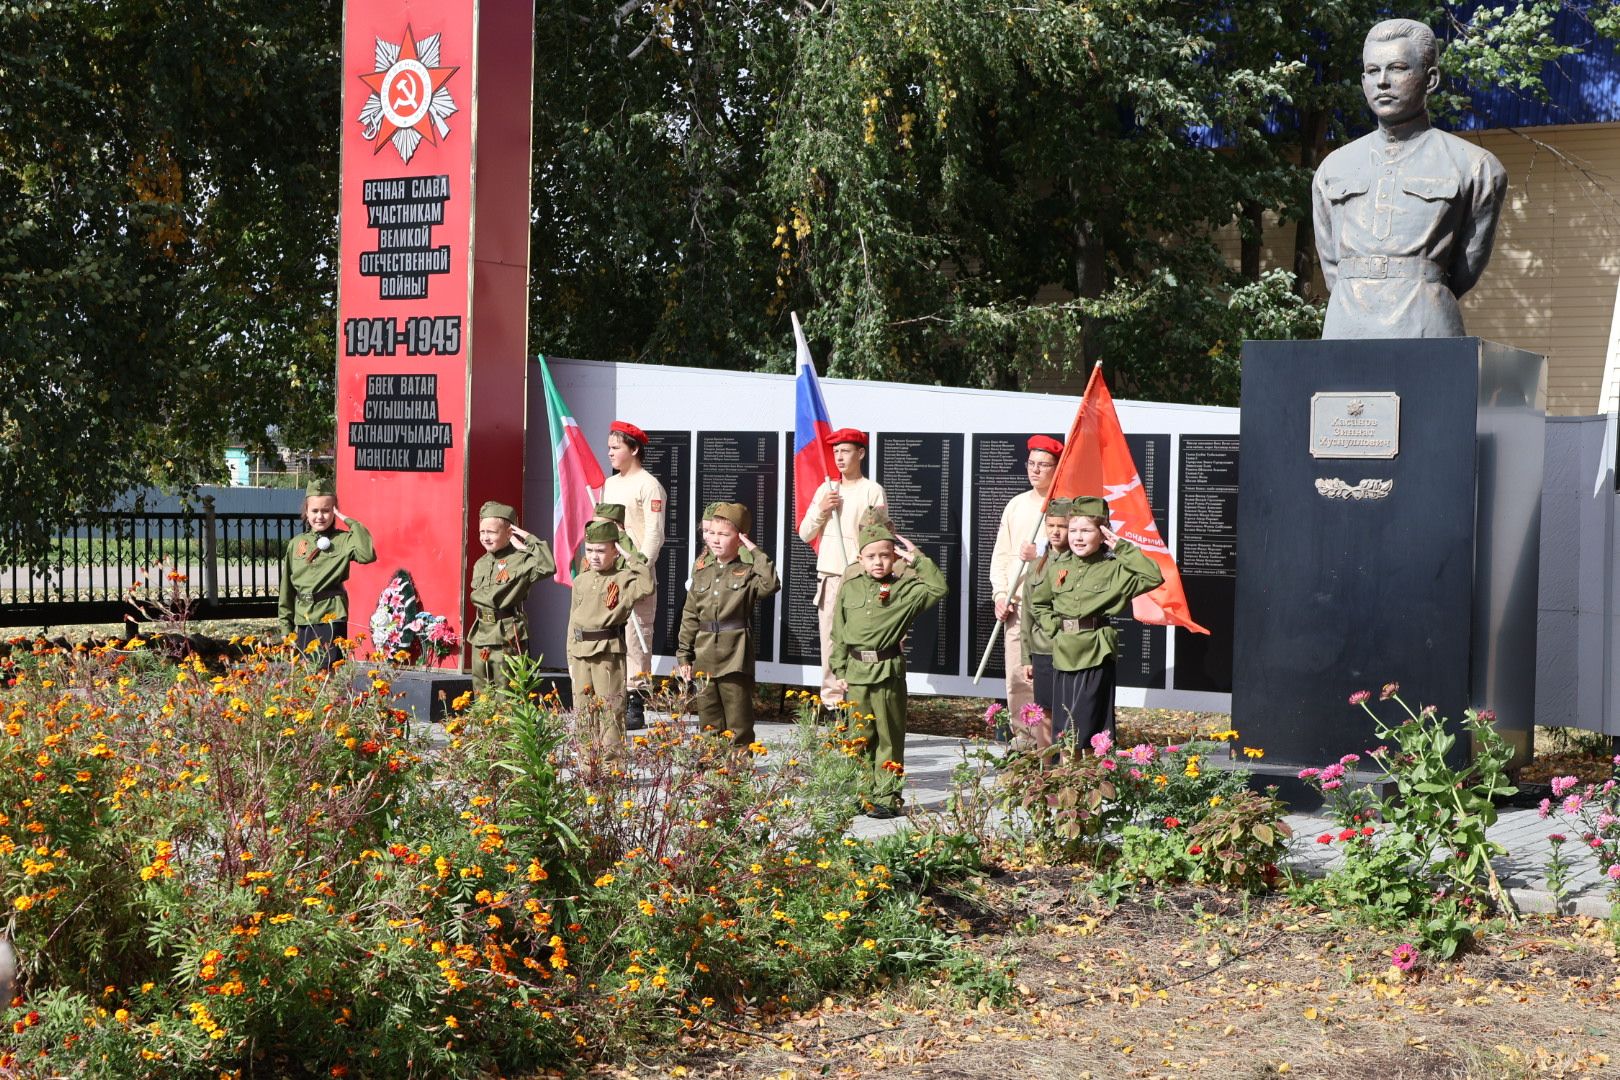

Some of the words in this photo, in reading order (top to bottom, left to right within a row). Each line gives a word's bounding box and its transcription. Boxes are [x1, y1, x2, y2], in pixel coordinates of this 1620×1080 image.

[364, 180, 405, 201] ВЕЧНАЯ
[411, 177, 448, 198] СЛАВА
[368, 202, 441, 225] УЧАСТНИКАМ
[380, 225, 429, 249] ВЕЛИКОЙ
[361, 248, 448, 273] ОТЕЧЕСТВЕННОЙ
[381, 274, 426, 296] ВОЙНЫ!
[345, 318, 460, 354] 1941-1945
[368, 376, 394, 396] БӨЕК
[400, 376, 435, 395] ВАТАН
[365, 400, 437, 420] СУГЫШЫНДА
[350, 424, 451, 444] КАТНАШУЧЫЛАРГА
[356, 448, 410, 470] МӘҢГЕЛЕК
[416, 449, 442, 469] ДАН!
